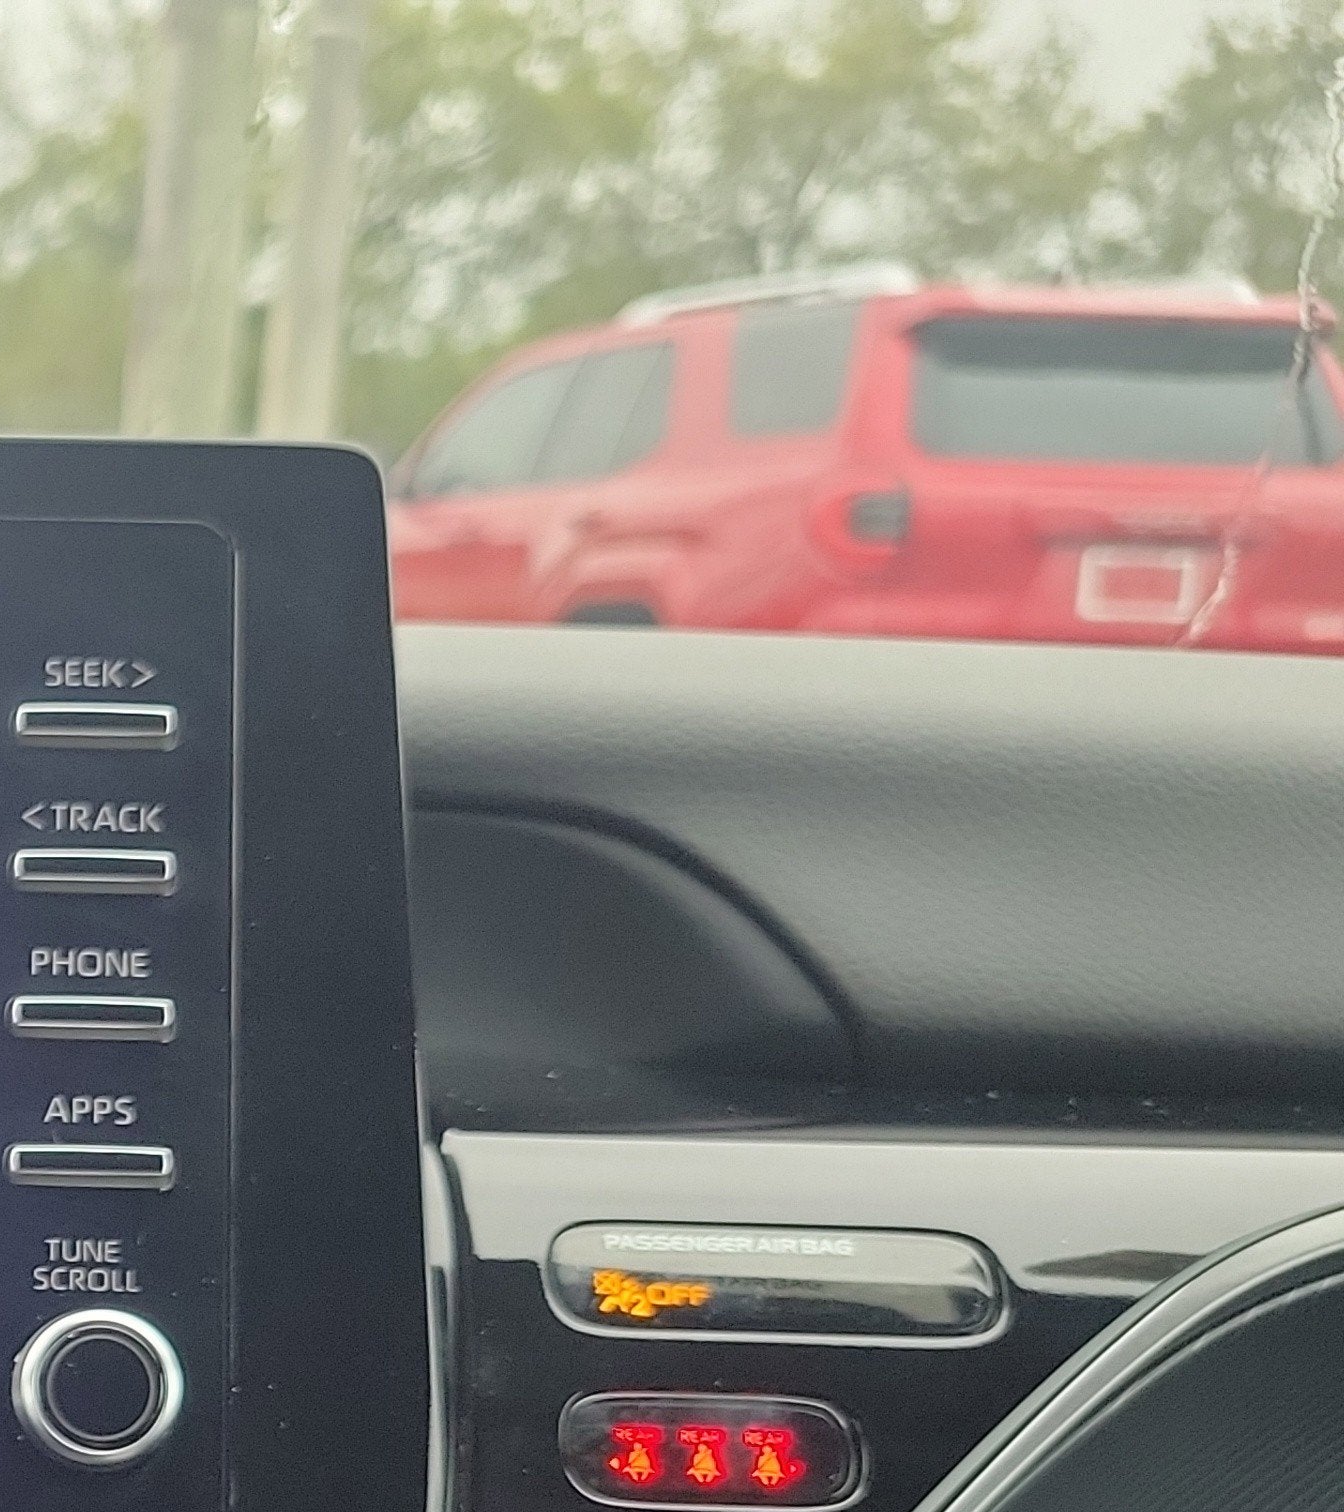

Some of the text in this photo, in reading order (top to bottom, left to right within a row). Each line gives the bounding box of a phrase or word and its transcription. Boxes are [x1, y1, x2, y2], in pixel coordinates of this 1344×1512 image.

[30, 950, 151, 980] PHONE
[43, 1097, 137, 1126] APPS
[44, 1237, 122, 1263] TUNE
[603, 1233, 856, 1257] PASSENGER AIR BAG
[33, 1266, 144, 1293] SCROLL
[646, 1281, 712, 1307] OFF
